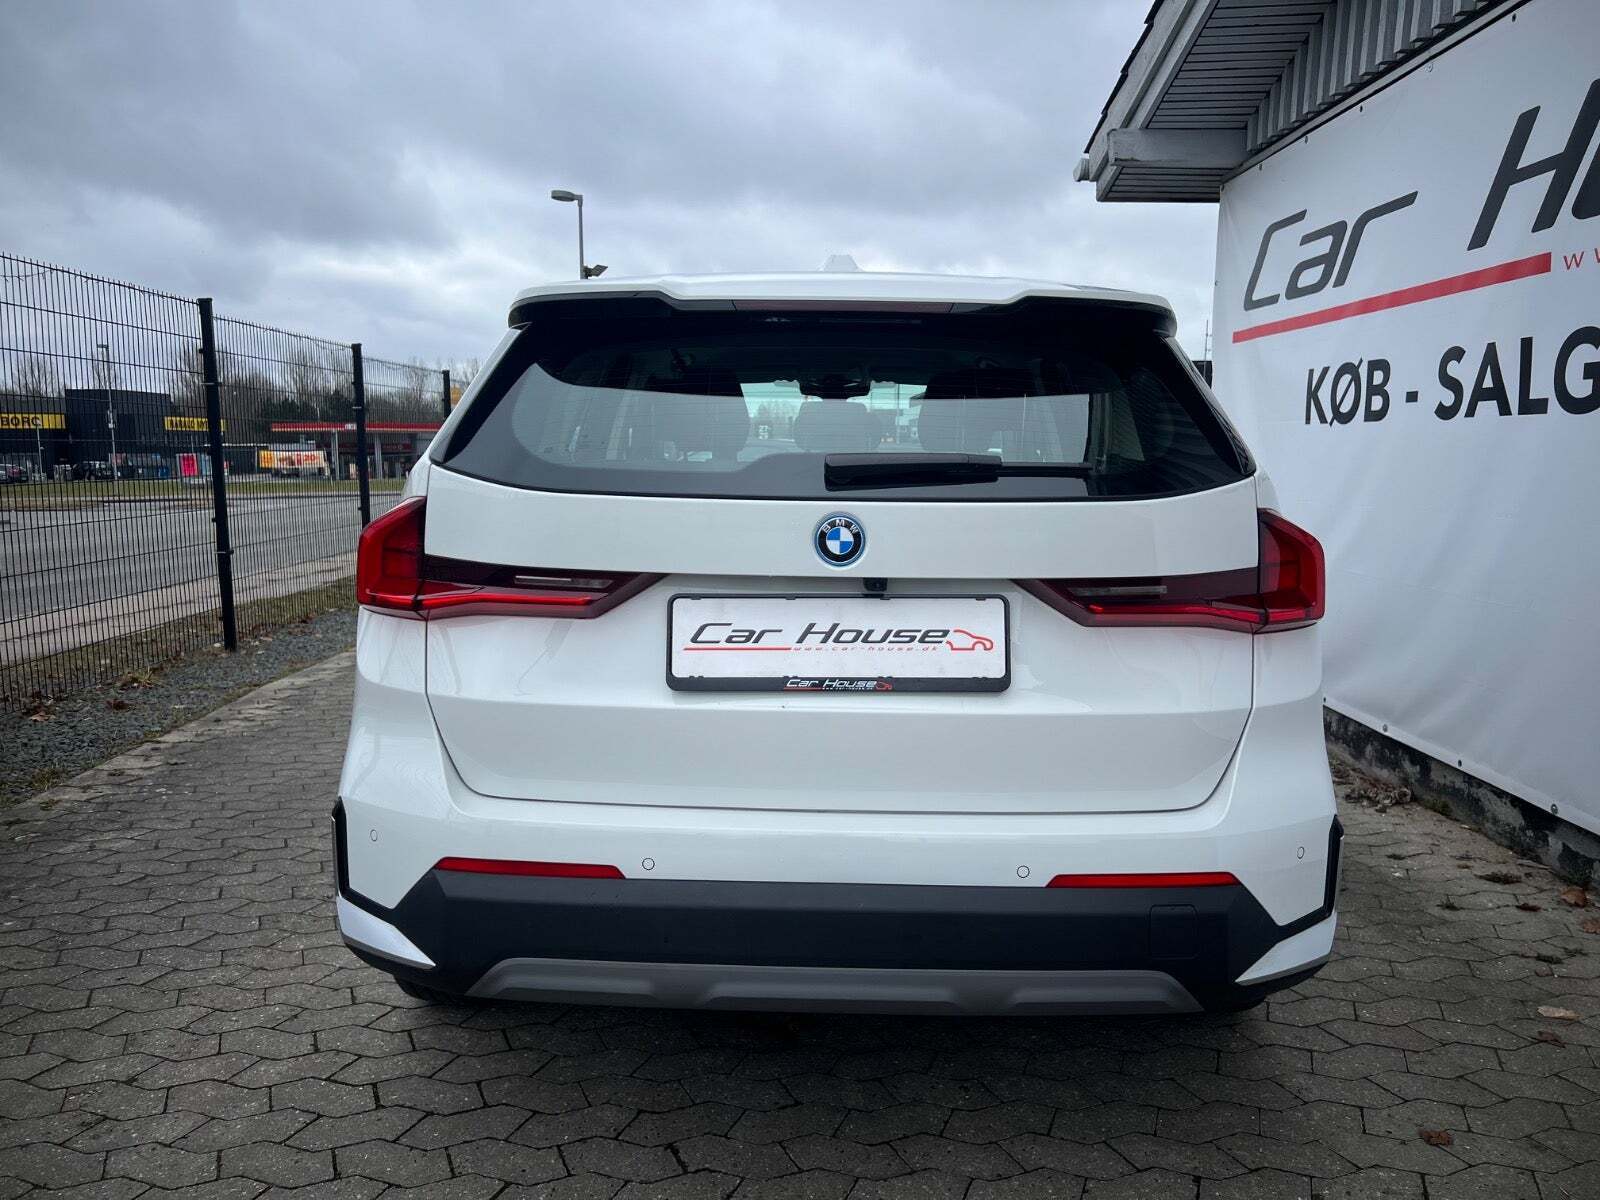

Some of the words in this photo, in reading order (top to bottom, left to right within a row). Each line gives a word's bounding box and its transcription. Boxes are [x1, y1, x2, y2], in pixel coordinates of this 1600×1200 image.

[1243, 190, 1419, 311] Car
[1304, 356, 1391, 427] KØB
[1434, 325, 1600, 421] SALG
[821, 519, 859, 534] BMW
[690, 622, 783, 644] Car
[795, 622, 951, 644] House
[786, 678, 819, 687] Car
[822, 678, 877, 688] House
